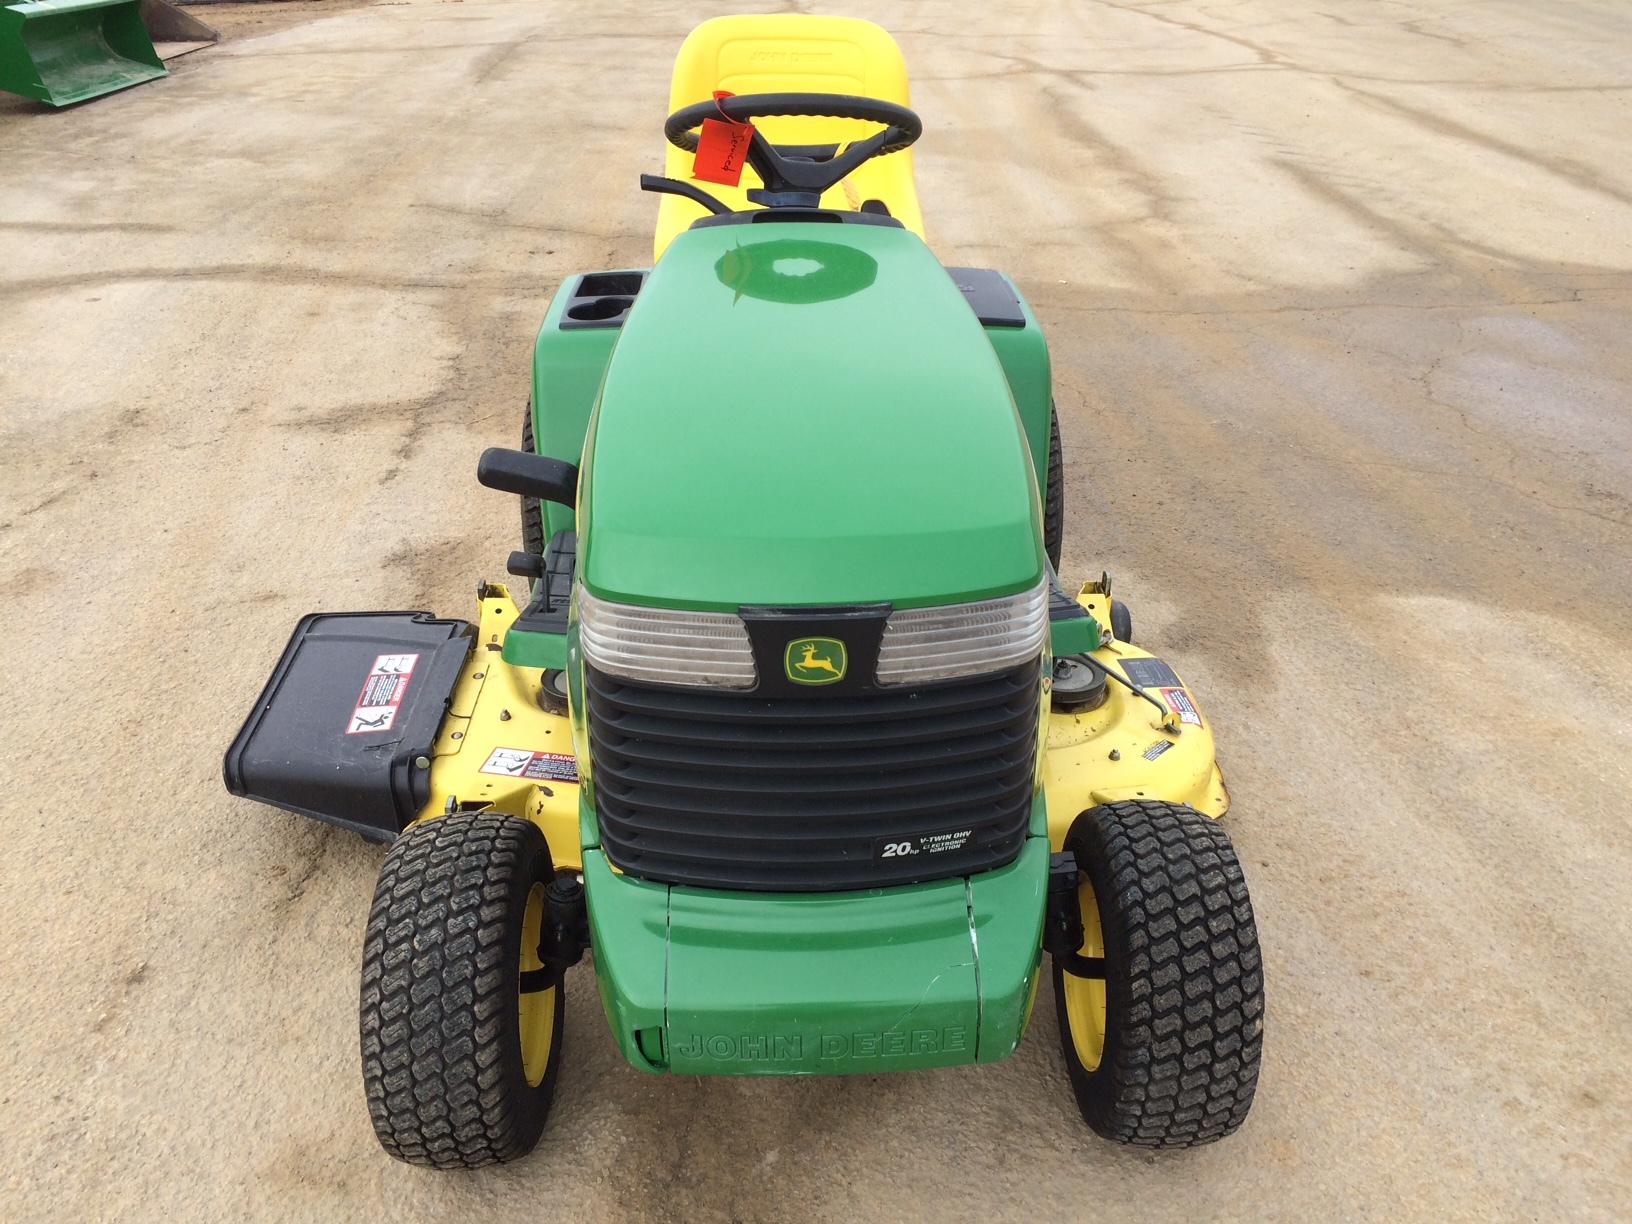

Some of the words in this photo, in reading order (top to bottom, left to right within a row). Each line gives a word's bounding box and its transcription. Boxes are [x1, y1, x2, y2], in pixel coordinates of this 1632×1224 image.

[920, 834, 952, 844] V-TWIN
[953, 830, 972, 839] OHV
[929, 844, 961, 853] IGNITION
[679, 1034, 803, 1061] JOHN
[820, 1026, 966, 1060] DEERE
